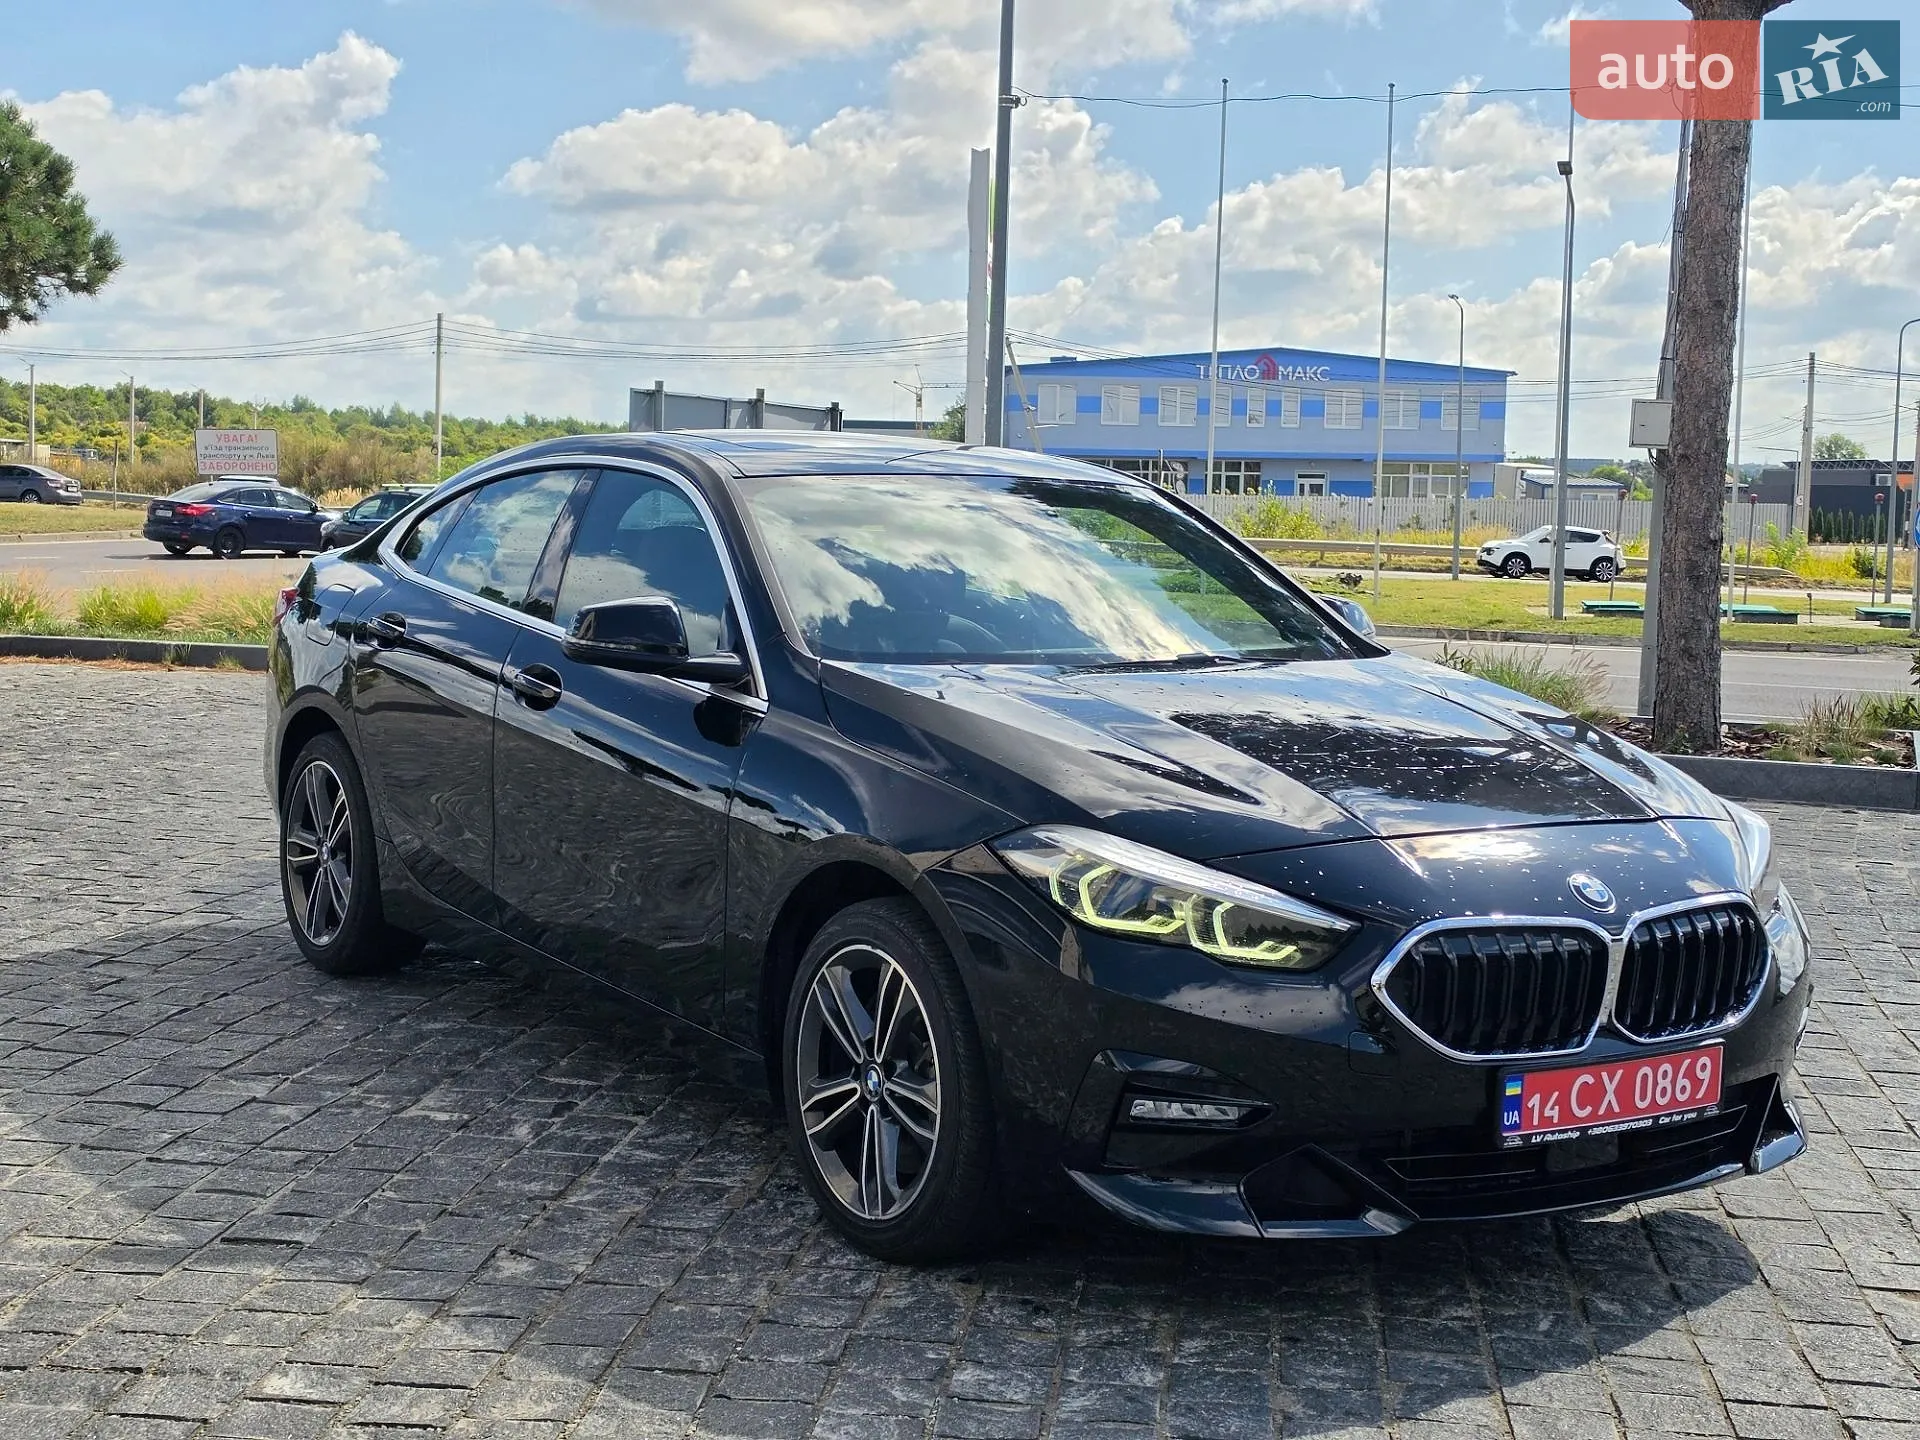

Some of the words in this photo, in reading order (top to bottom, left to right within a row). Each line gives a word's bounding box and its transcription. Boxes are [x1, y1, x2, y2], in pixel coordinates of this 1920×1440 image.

[1278, 365, 1330, 381] МАКС
[216, 433, 258, 443] УВАГА!
[199, 461, 276, 471] ЗАБОРОНЕНО
[1527, 1091, 1560, 1126] 14
[1570, 1069, 1624, 1118] CX
[1634, 1056, 1712, 1109] 0869
[1503, 1111, 1520, 1126] UA
[1531, 1134, 1544, 1143] LV
[1658, 1116, 1671, 1124] Car
[1671, 1113, 1682, 1122] for
[1683, 1111, 1697, 1121] you
